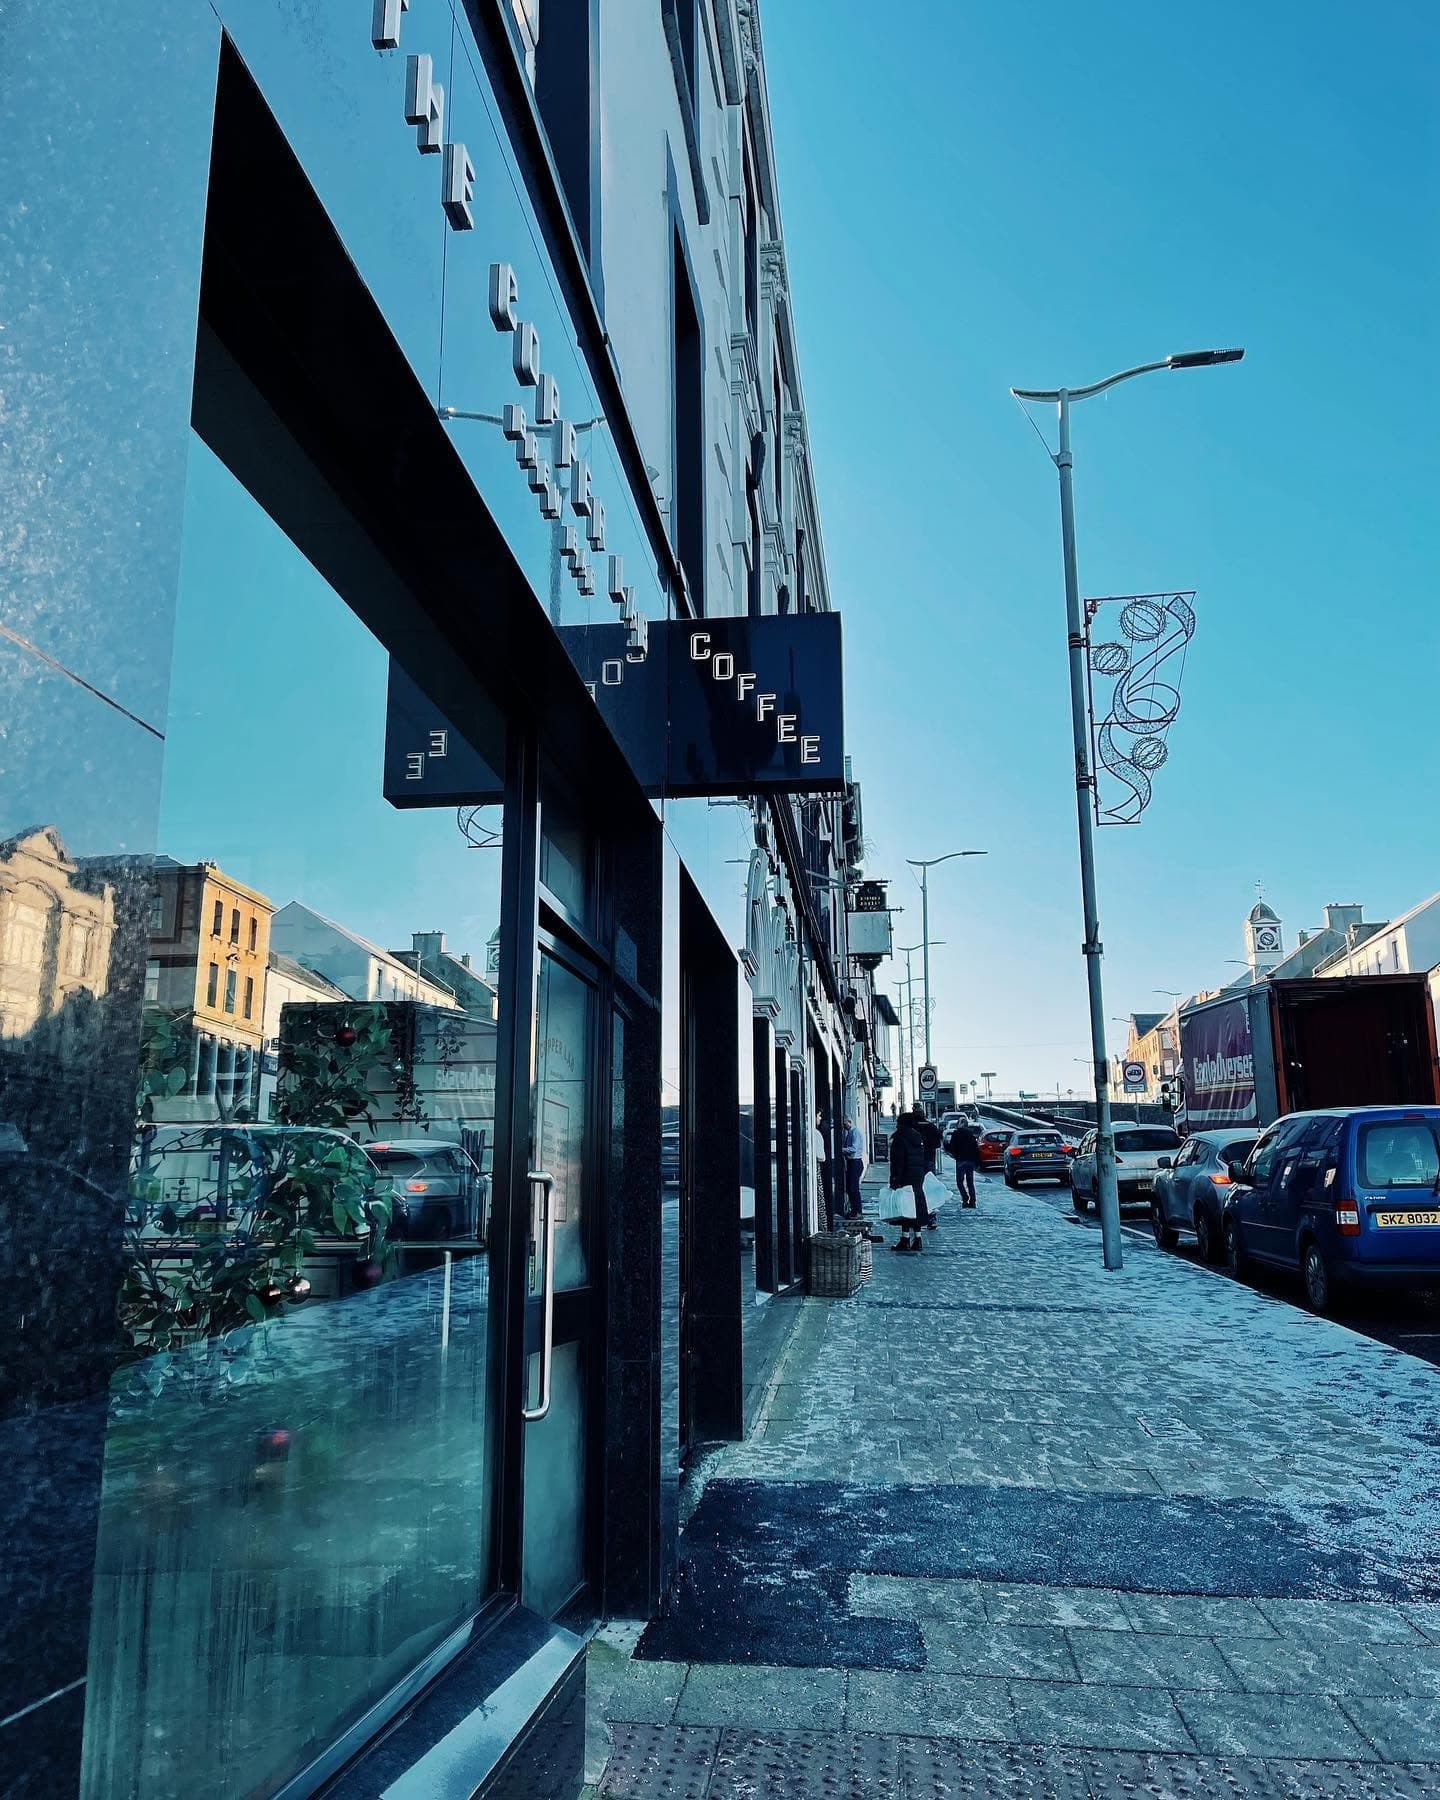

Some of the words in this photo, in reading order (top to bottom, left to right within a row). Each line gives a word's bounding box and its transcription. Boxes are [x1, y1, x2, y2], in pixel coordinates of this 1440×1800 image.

[690, 632, 821, 764] COFFEE
[1381, 1214, 1405, 1225] SKZ
[1407, 1213, 1438, 1224] 8032
